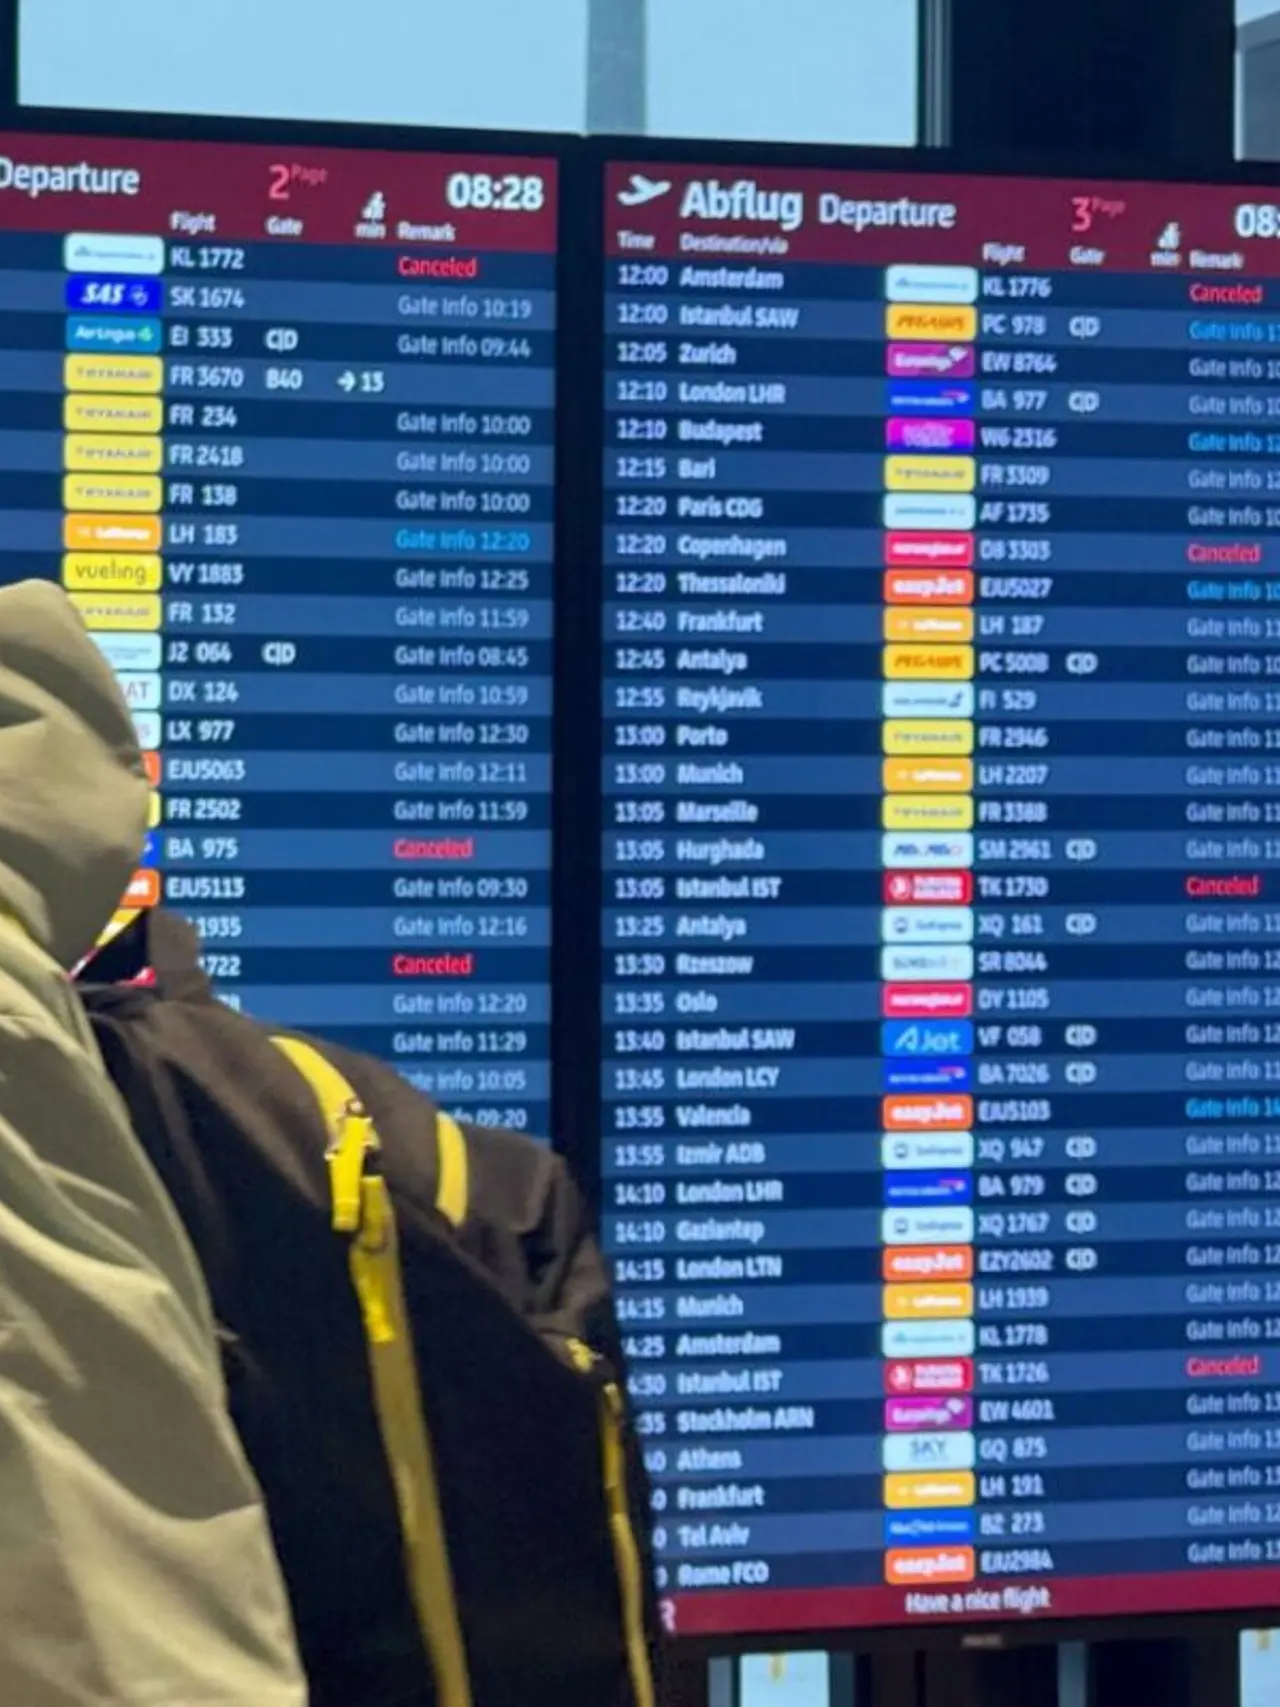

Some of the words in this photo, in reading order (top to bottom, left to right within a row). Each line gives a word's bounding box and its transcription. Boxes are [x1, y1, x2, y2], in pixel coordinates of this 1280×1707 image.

[269, 164, 291, 200] 2
[446, 172, 545, 211] 08:28
[679, 179, 804, 232] Abflug
[818, 192, 957, 233] Departure
[1071, 196, 1092, 232] 3
[169, 211, 217, 236] Flight
[266, 215, 304, 237] Gate
[355, 221, 387, 240] min
[396, 221, 457, 243] Remark
[617, 230, 656, 250] Time
[170, 247, 196, 268] KL
[198, 248, 246, 269] 1772
[397, 256, 479, 279] Canceled
[617, 265, 669, 286] 12:00
[679, 266, 784, 290] Amsterdam
[1189, 283, 1264, 304] Canceled
[80, 281, 126, 305] SAS
[170, 286, 196, 307] SK
[198, 287, 246, 308] 1674
[397, 294, 439, 317] Gate
[441, 296, 478, 318] Info
[483, 298, 532, 319] 10:19
[617, 303, 669, 324] 12:00
[679, 304, 753, 327] Istanbul
[754, 307, 799, 328] SAW
[196, 327, 233, 348] 333
[397, 333, 439, 356] Gate
[441, 336, 478, 358] Info
[480, 336, 532, 359] 09:44
[679, 343, 737, 365] Zurich
[170, 365, 194, 386] FR
[198, 366, 245, 388] 3670
[679, 381, 747, 403] London
[748, 383, 787, 404] LHR
[170, 405, 194, 425] FR
[202, 406, 238, 427] 234
[679, 419, 763, 445] Budapest
[678, 457, 716, 479] Bari
[678, 496, 723, 518] Paris
[725, 498, 764, 519] CDG
[75, 558, 147, 585] vueling
[677, 610, 764, 632] Frankfurt
[167, 759, 246, 781] EJU5063
[677, 763, 744, 784] Munich
[394, 838, 474, 860] Canceled
[166, 876, 246, 899] EJU5113
[676, 991, 718, 1013] Oslo
[676, 1104, 751, 1127] Valencia
[676, 1447, 742, 1471] Athens
[732, 1561, 769, 1584] FCO
[904, 1591, 949, 1615] Have
[950, 1595, 964, 1613] a
[964, 1588, 1001, 1612] nice
